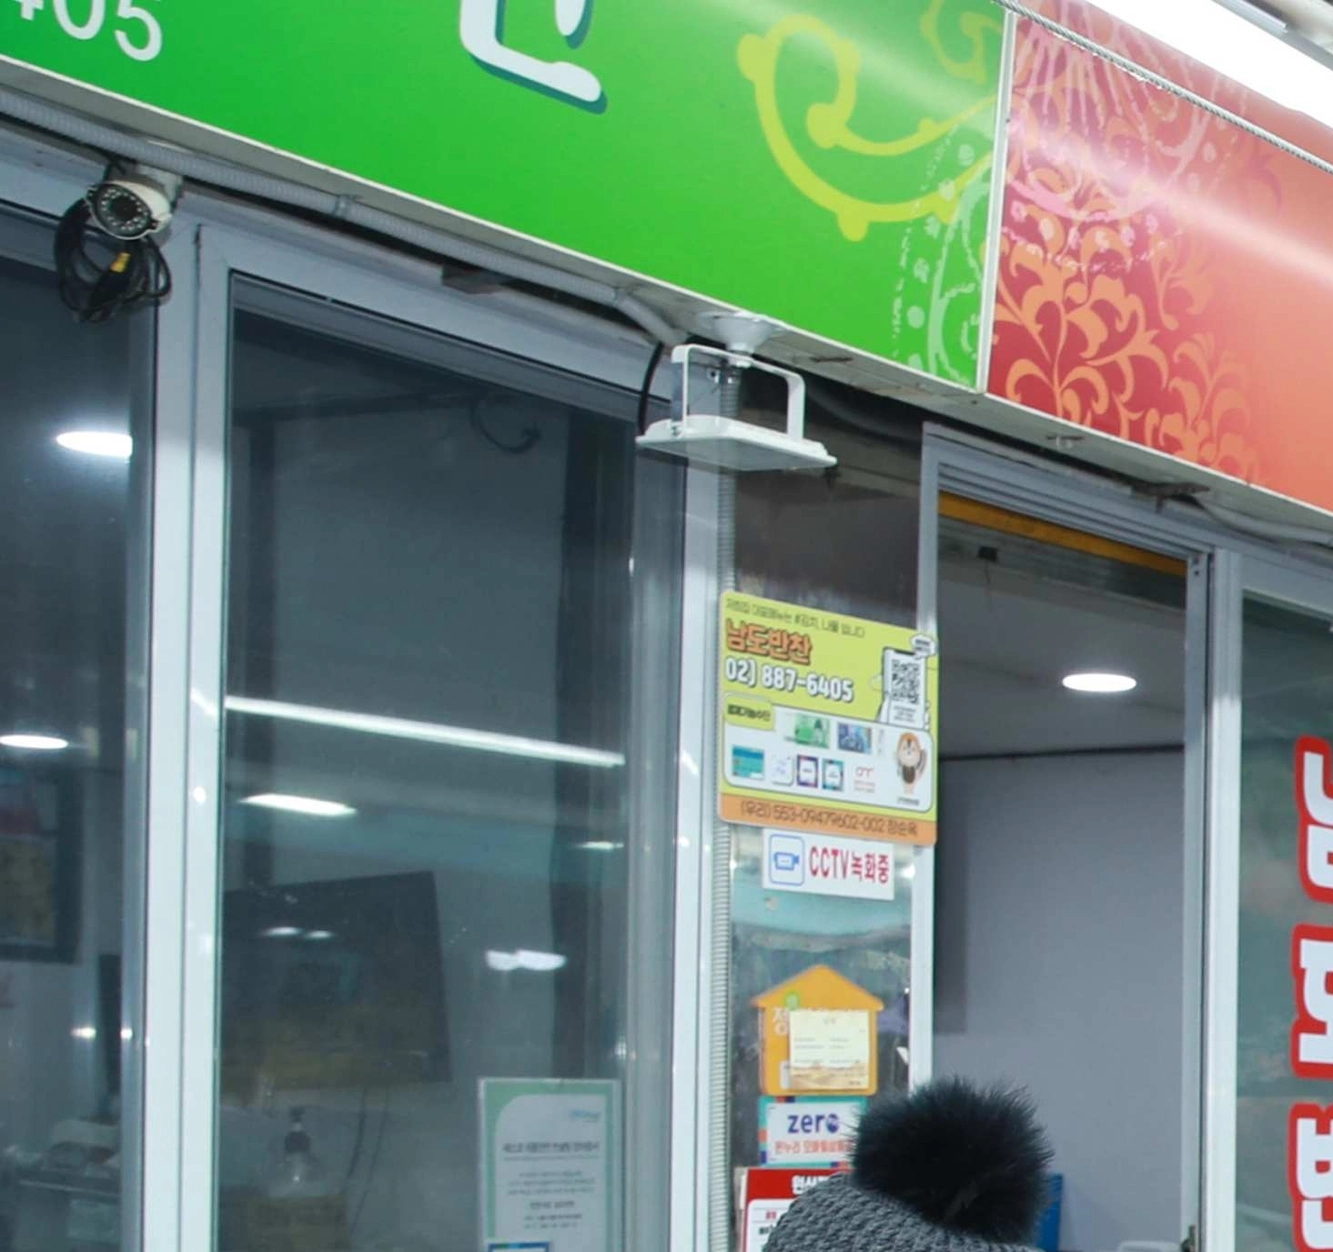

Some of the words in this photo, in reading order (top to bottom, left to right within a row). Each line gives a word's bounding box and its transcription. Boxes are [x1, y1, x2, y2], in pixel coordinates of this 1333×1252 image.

[725, 617, 813, 666] 남도반찬
[760, 662, 855, 704] 887-6405
[809, 845, 850, 881] CCTV
[850, 851, 890, 885] 녹화중
[787, 1113, 841, 1134] zero
